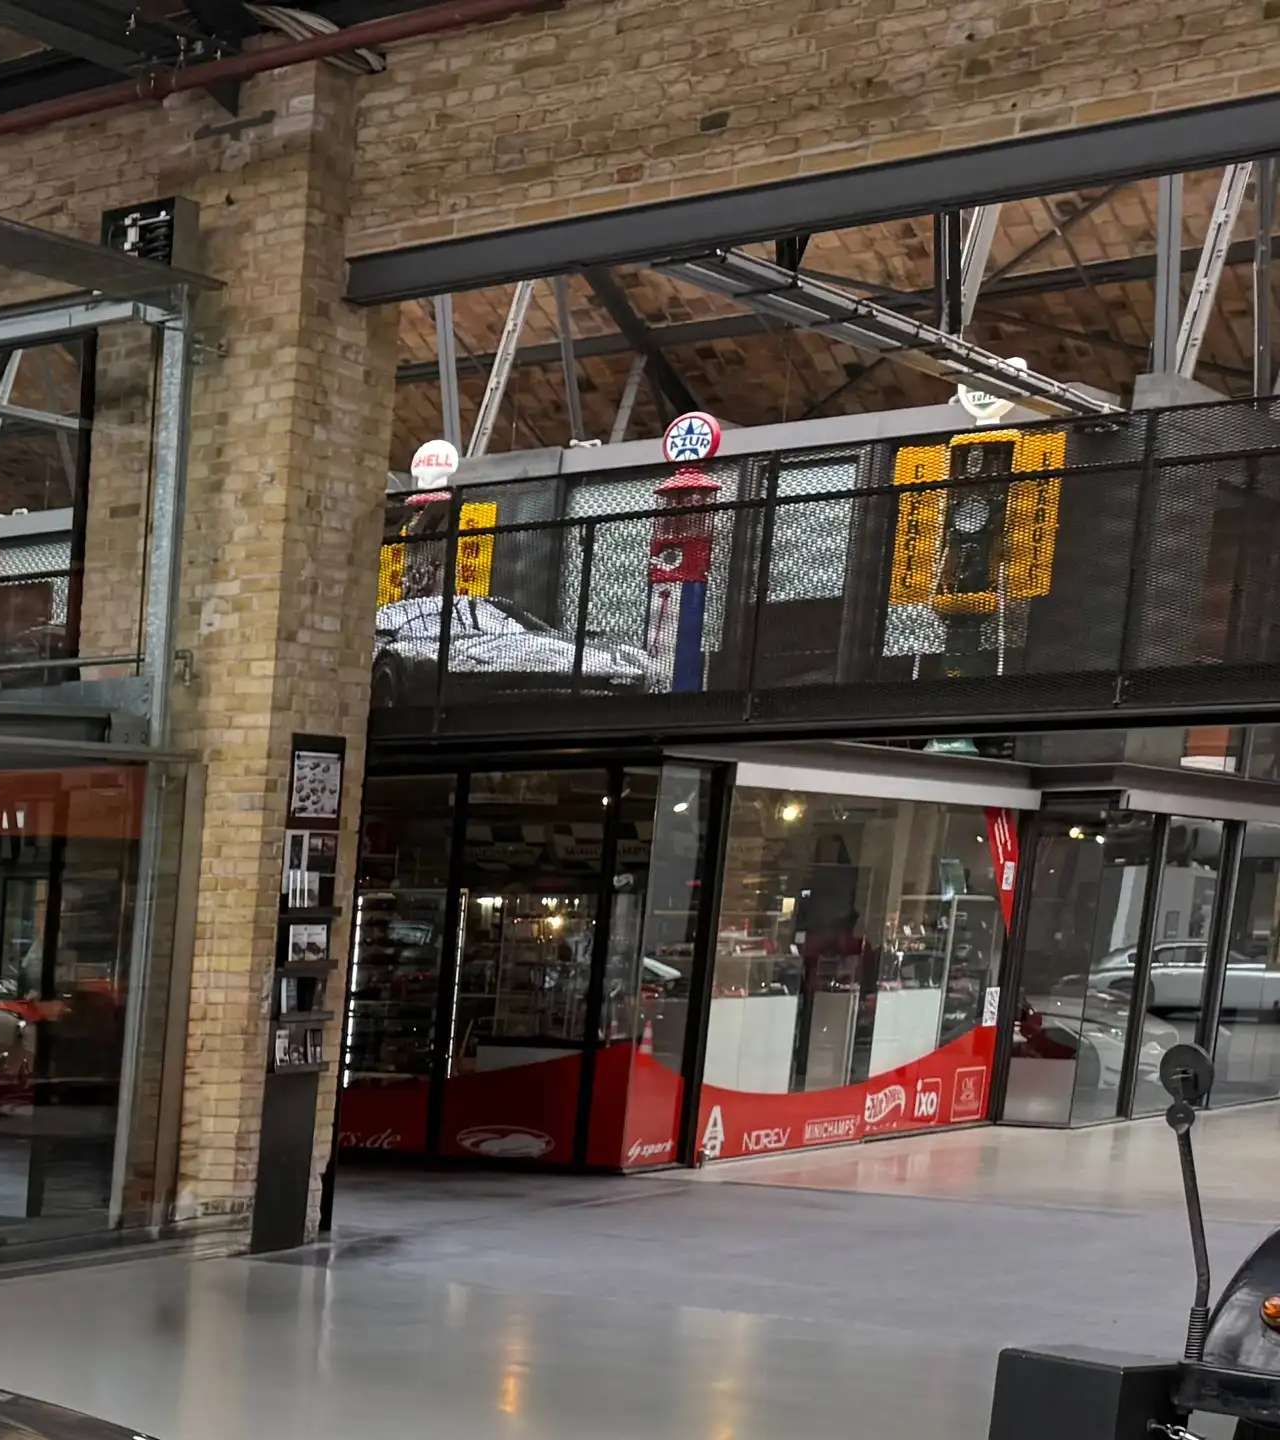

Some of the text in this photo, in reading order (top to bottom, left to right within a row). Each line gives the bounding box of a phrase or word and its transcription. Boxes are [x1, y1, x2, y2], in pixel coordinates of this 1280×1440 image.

[670, 436, 710, 452] AZUR
[413, 453, 453, 469] SHELL
[914, 1078, 937, 1117] ixo
[742, 1127, 791, 1151] NOREV
[804, 1118, 855, 1141] MINICHAMPS
